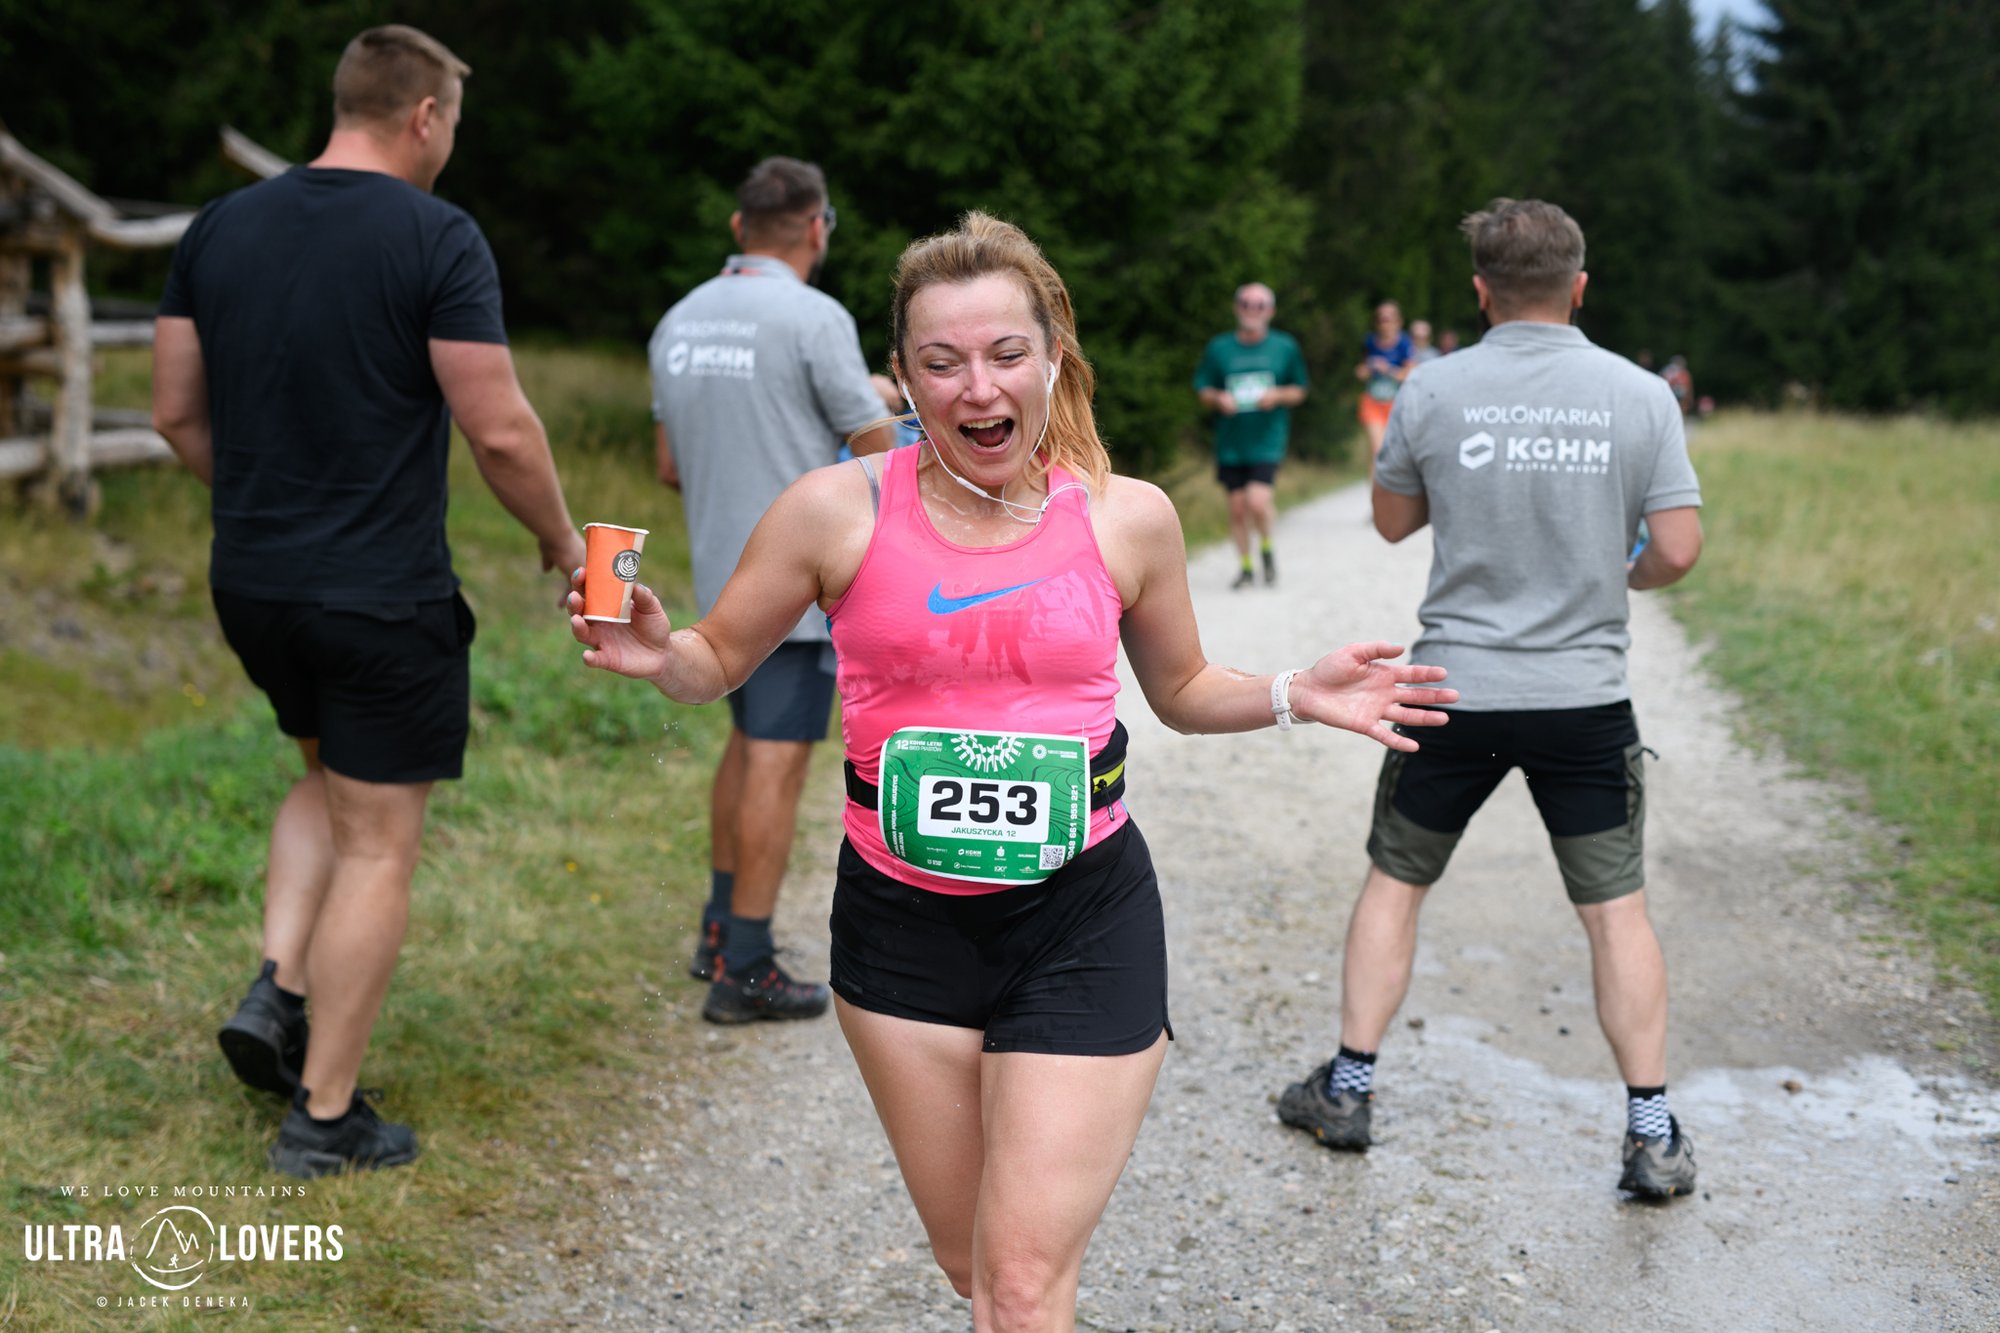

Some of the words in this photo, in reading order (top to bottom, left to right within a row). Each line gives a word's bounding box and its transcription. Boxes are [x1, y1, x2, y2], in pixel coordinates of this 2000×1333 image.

[1463, 405, 1612, 427] WOLONTARIAT
[1507, 437, 1611, 463] KGHM
[895, 740, 909, 750] 12
[930, 780, 1038, 825] 253
[951, 827, 1003, 836] JAKUSZYCKA
